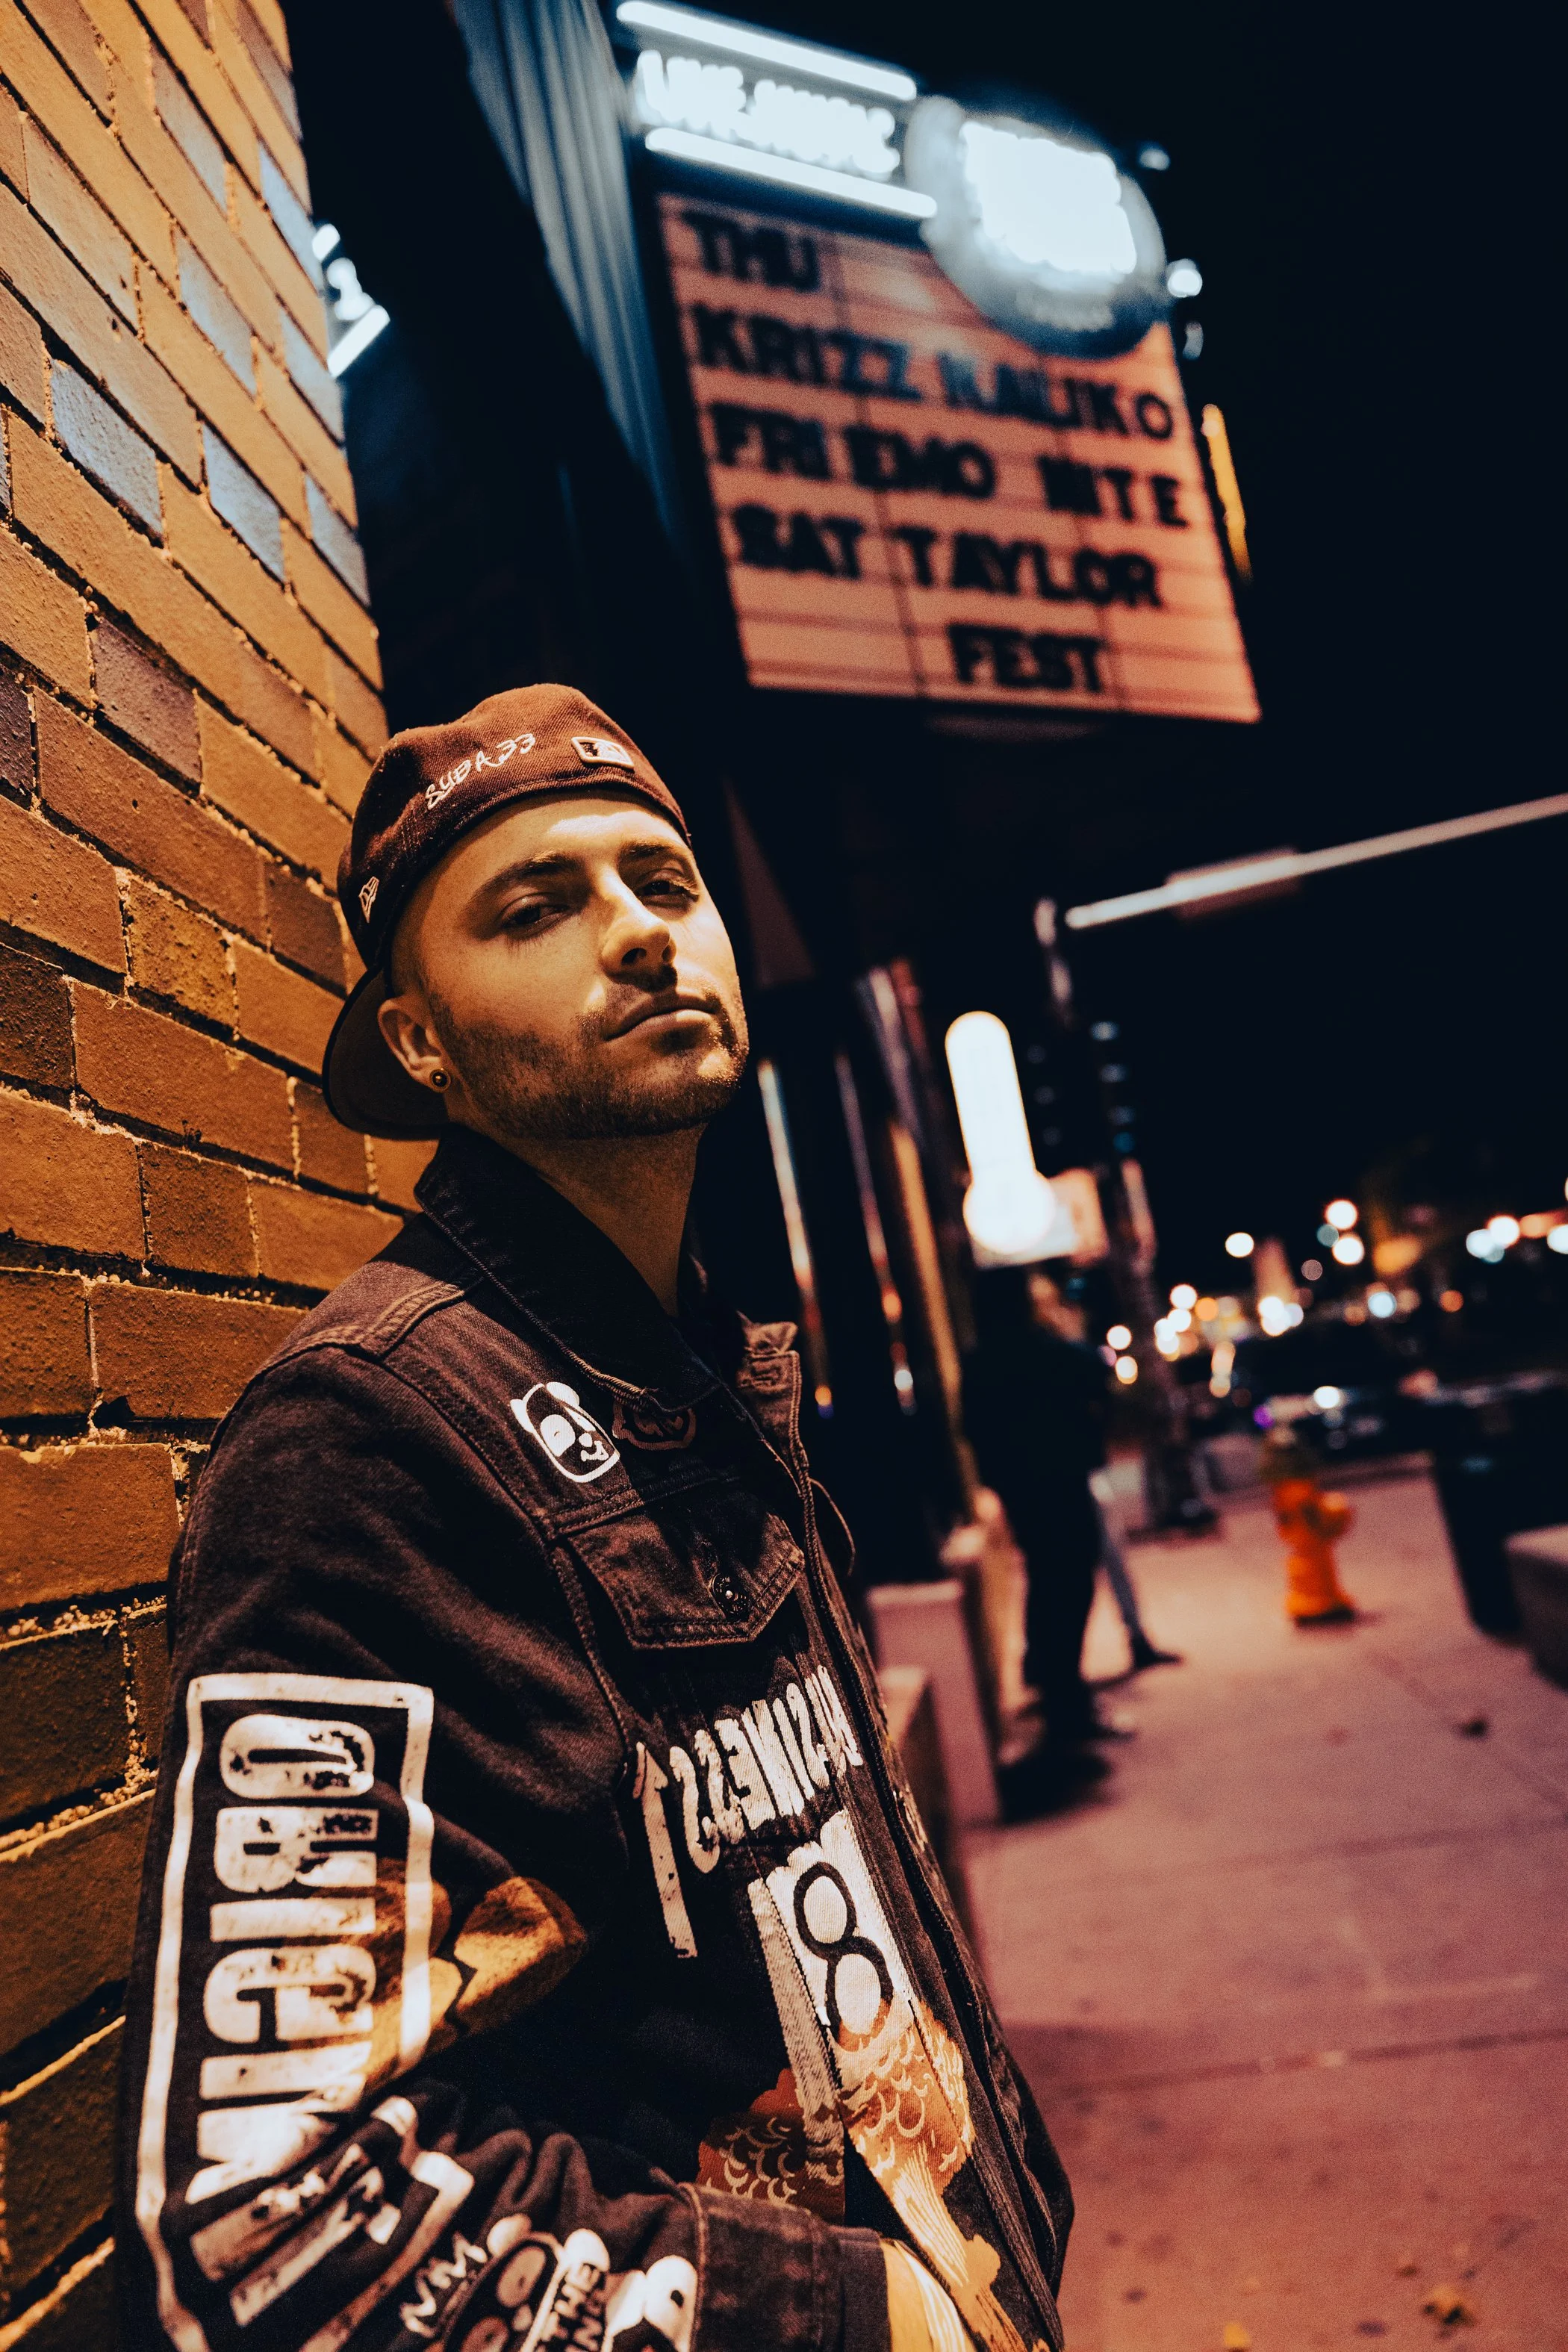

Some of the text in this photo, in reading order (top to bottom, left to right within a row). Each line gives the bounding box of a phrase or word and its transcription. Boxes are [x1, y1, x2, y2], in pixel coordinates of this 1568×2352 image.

[682, 209, 819, 293] THU
[691, 300, 923, 403] KRIZZ
[707, 401, 830, 482] FRI
[732, 504, 1162, 609] SAT TAYLOR
[948, 623, 1105, 694] FEST
